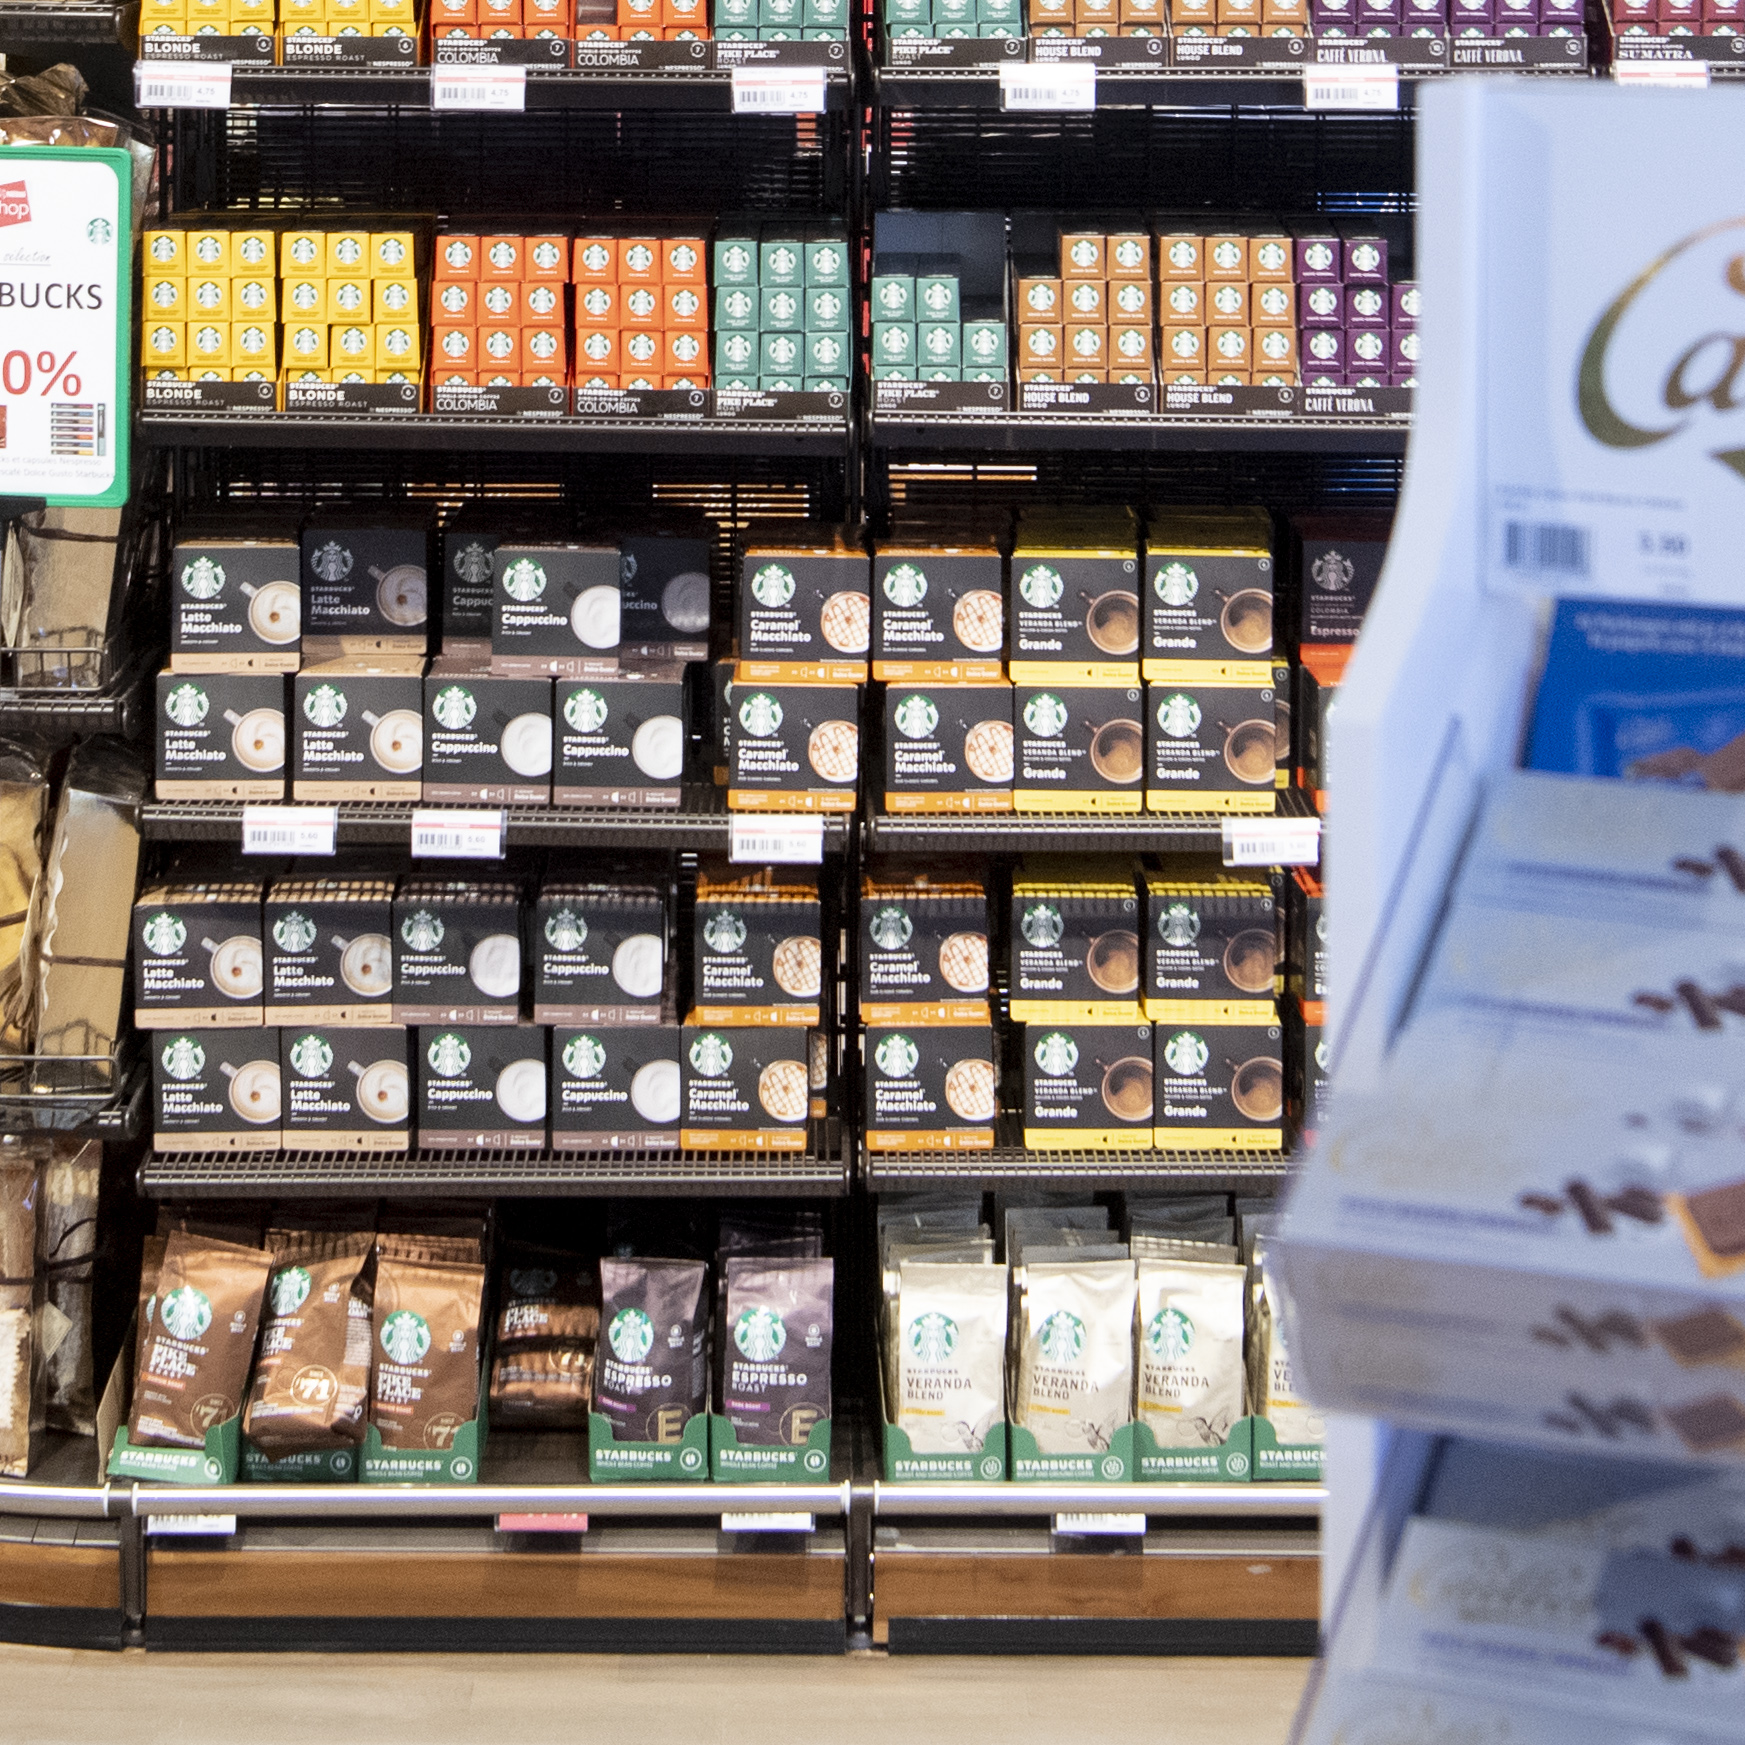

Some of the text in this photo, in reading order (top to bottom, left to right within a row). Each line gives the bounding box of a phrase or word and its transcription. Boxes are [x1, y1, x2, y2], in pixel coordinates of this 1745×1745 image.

[286, 44, 342, 54] BLONDE
[1619, 49, 1693, 59] SUMATRA
[437, 52, 498, 63] COLOMBIA
[146, 389, 202, 399] BLONDE
[437, 400, 499, 412] COLOMBIA
[181, 612, 212, 622] Latte
[502, 615, 568, 627] Cappuccino
[181, 622, 242, 633] Macchiato
[751, 620, 800, 631] Caramel
[751, 631, 811, 643] Macchiato
[1019, 638, 1062, 651] Grande
[563, 745, 629, 758] Cappuccino
[732, 1372, 807, 1386] ESPRESSO
[907, 1377, 972, 1391] VERANDA
[908, 1391, 944, 1401] BLEND
[120, 1450, 198, 1468] STARBUCKS
[720, 1449, 795, 1462] STARBUCKS
